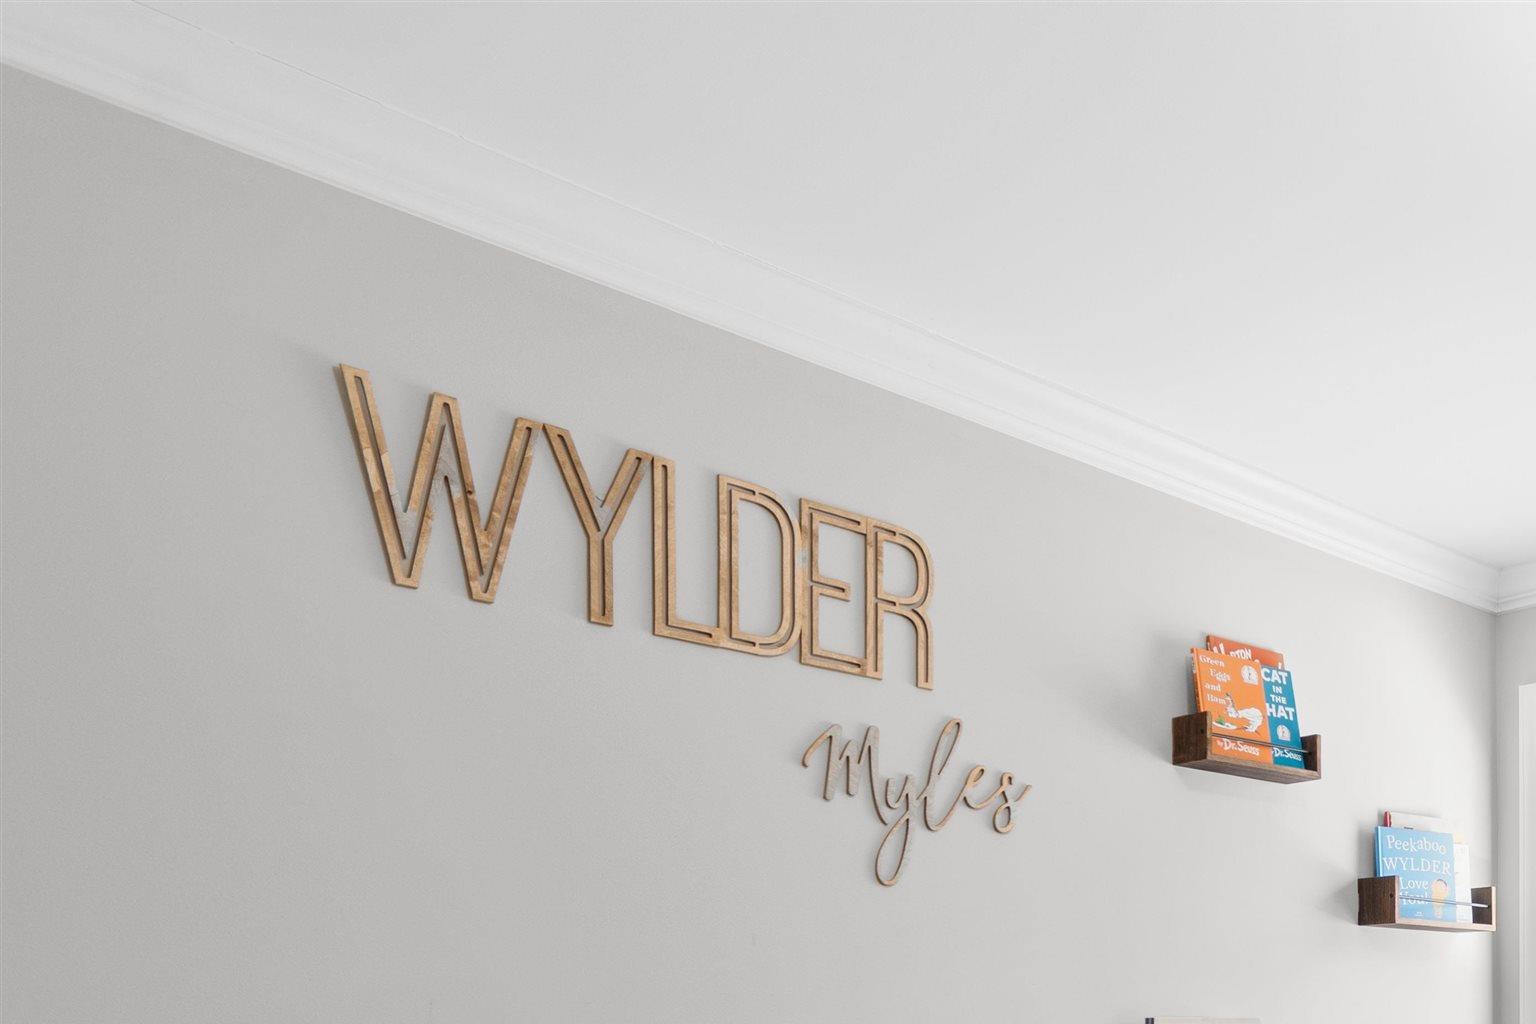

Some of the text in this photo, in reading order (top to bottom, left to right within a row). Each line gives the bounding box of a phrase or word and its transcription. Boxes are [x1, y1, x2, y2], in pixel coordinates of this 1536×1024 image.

[335, 363, 933, 691] WYLDER
[1199, 655, 1225, 667] Green
[1261, 667, 1288, 685] CAT
[1271, 685, 1283, 694] IN
[1269, 694, 1287, 705] THE
[1266, 702, 1295, 721] HAT
[801, 718, 1033, 887] Myles
[1387, 834, 1447, 855] Peekaboo
[1383, 857, 1452, 876] WYLDER
[1399, 877, 1429, 890] Love
